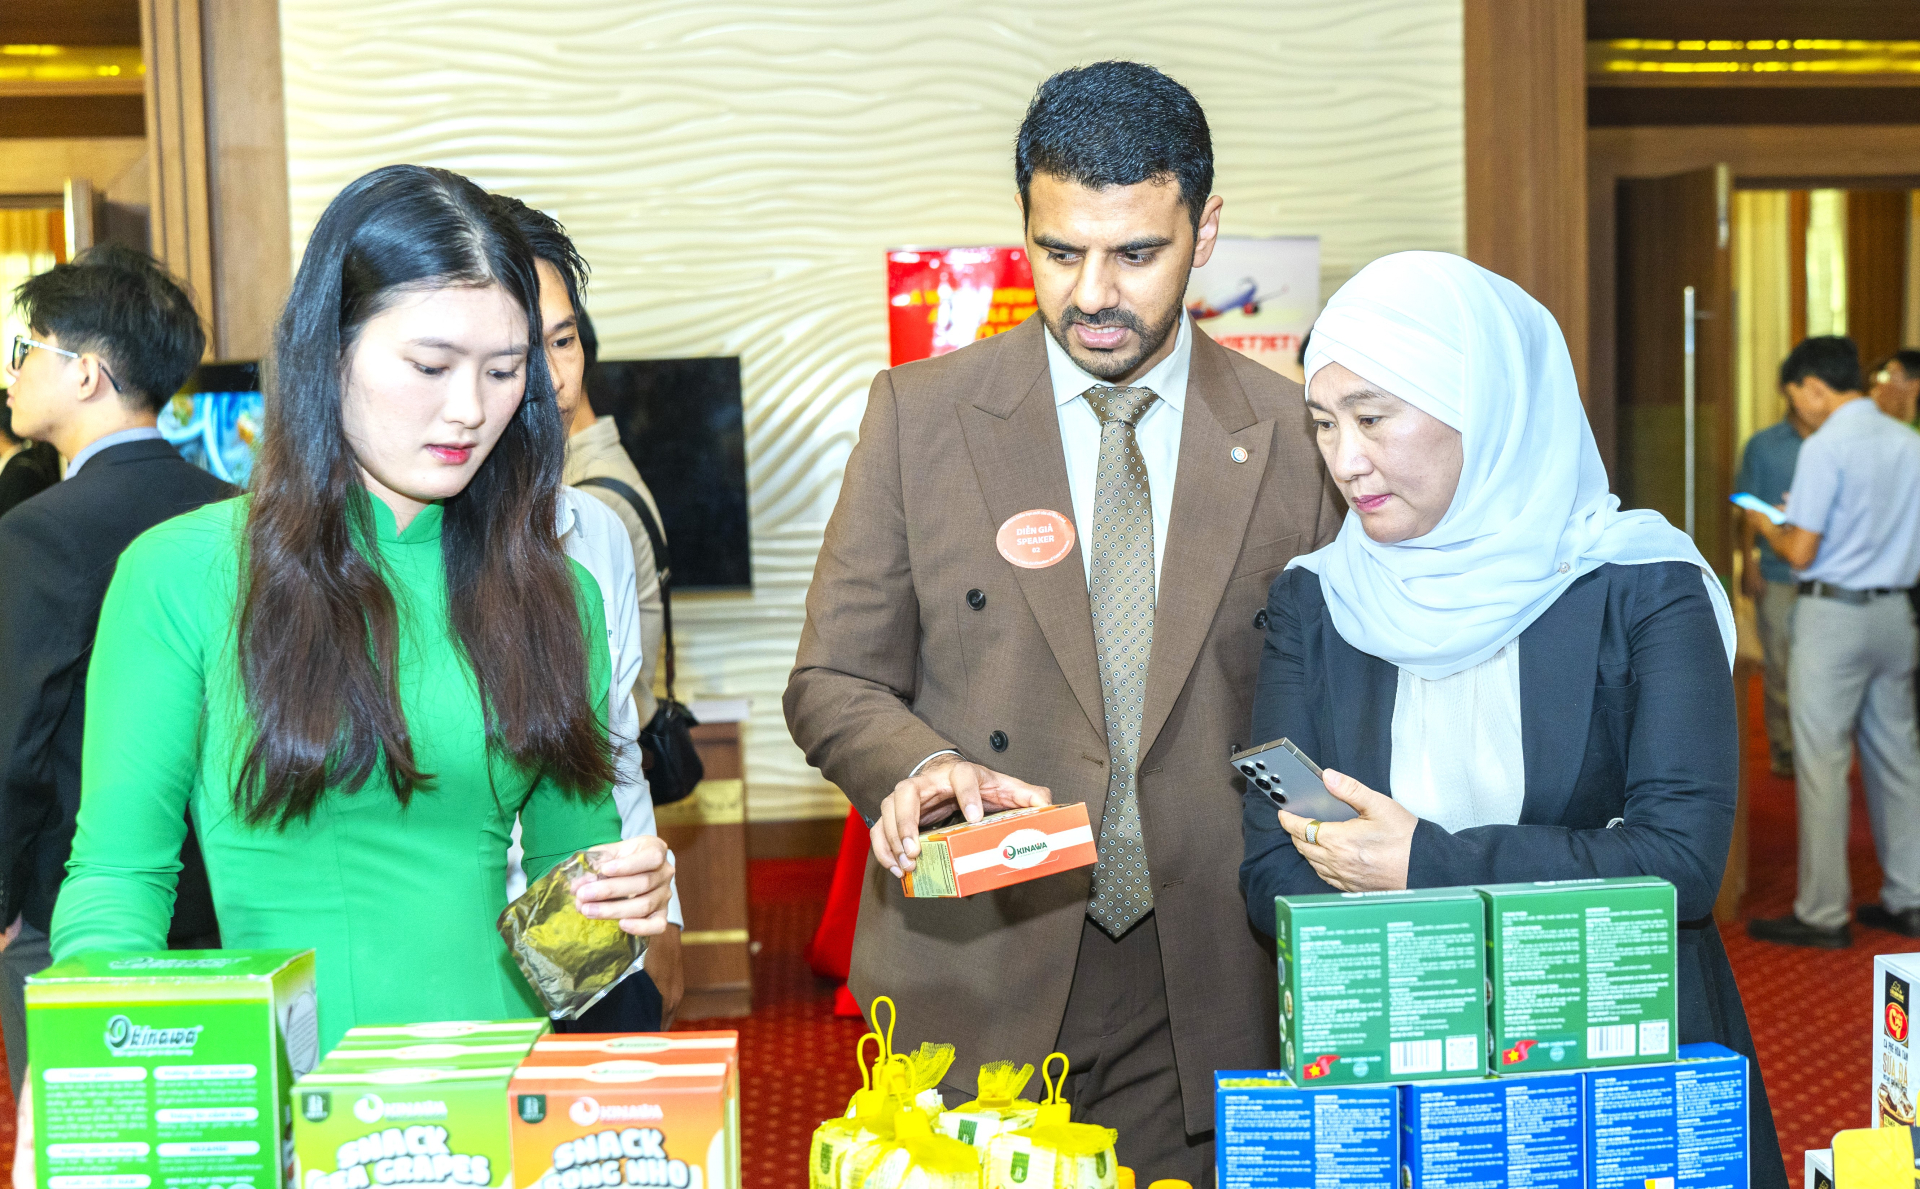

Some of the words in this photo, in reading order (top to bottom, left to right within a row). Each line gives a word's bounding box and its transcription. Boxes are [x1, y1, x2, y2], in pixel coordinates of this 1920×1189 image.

[1016, 535, 1055, 546] SPEAKER
[1031, 546, 1041, 554] 02
[336, 1125, 452, 1170] SNACK
[552, 1128, 667, 1171] SNACK
[374, 1153, 492, 1186] GRAPES
[624, 1158, 692, 1189] NHO
